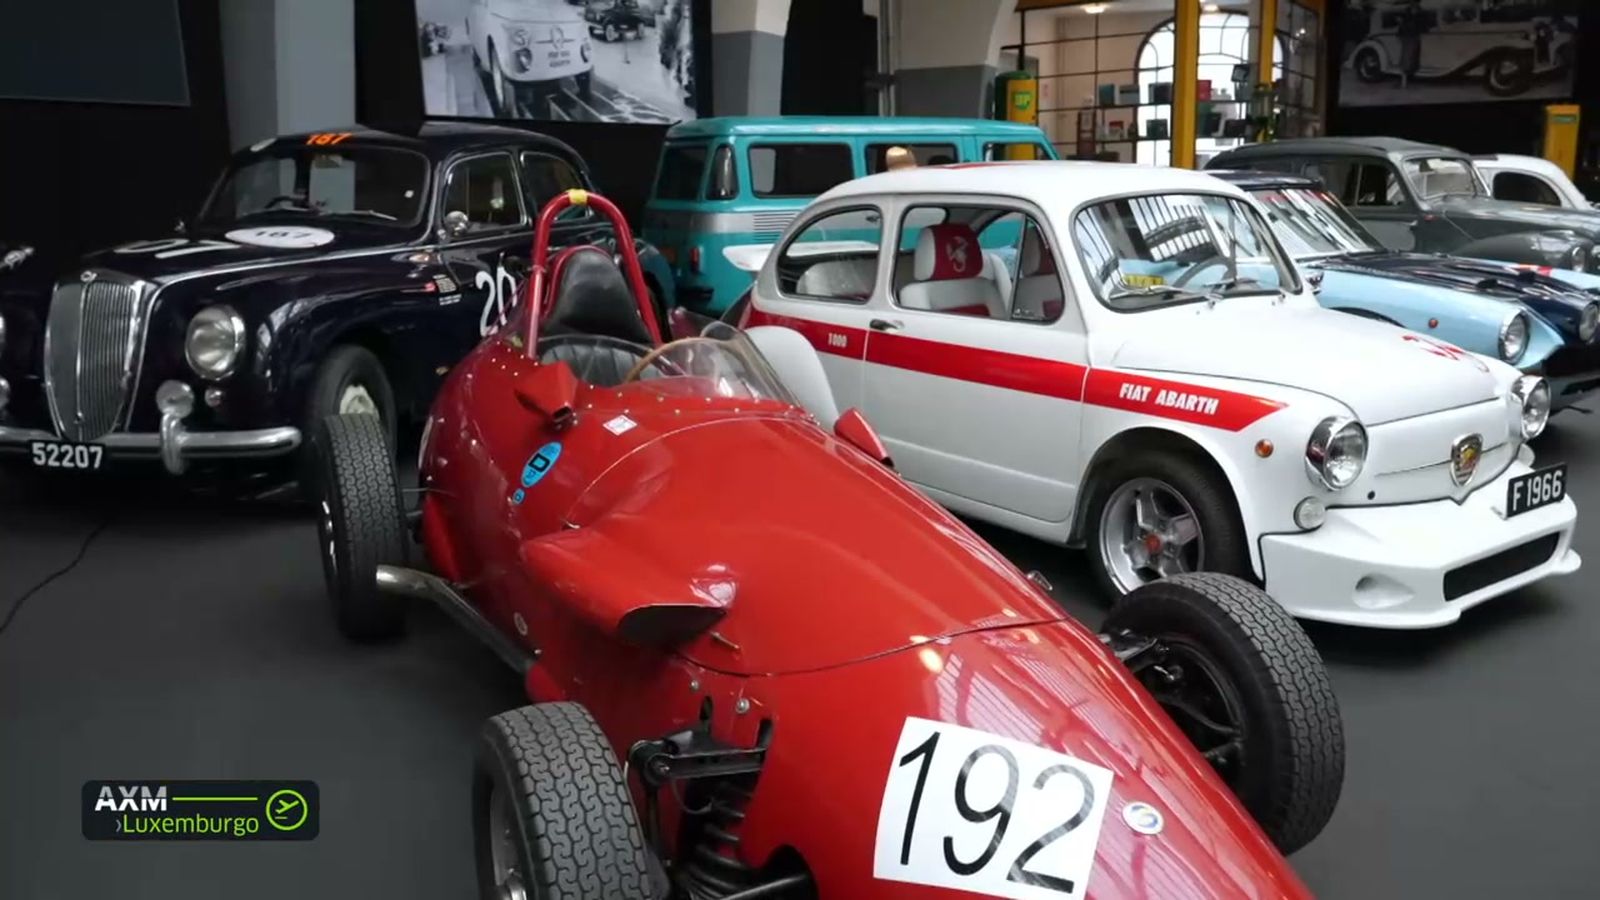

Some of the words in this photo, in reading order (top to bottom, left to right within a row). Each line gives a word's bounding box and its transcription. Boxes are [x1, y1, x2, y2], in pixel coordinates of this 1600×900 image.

[306, 132, 352, 145] 187
[1119, 383, 1152, 402] FIAT
[1154, 389, 1219, 415] ABARTH
[32, 442, 103, 469] 52207
[1513, 480, 1524, 511] F
[1527, 470, 1562, 507] 1966
[899, 731, 1095, 894] 192
